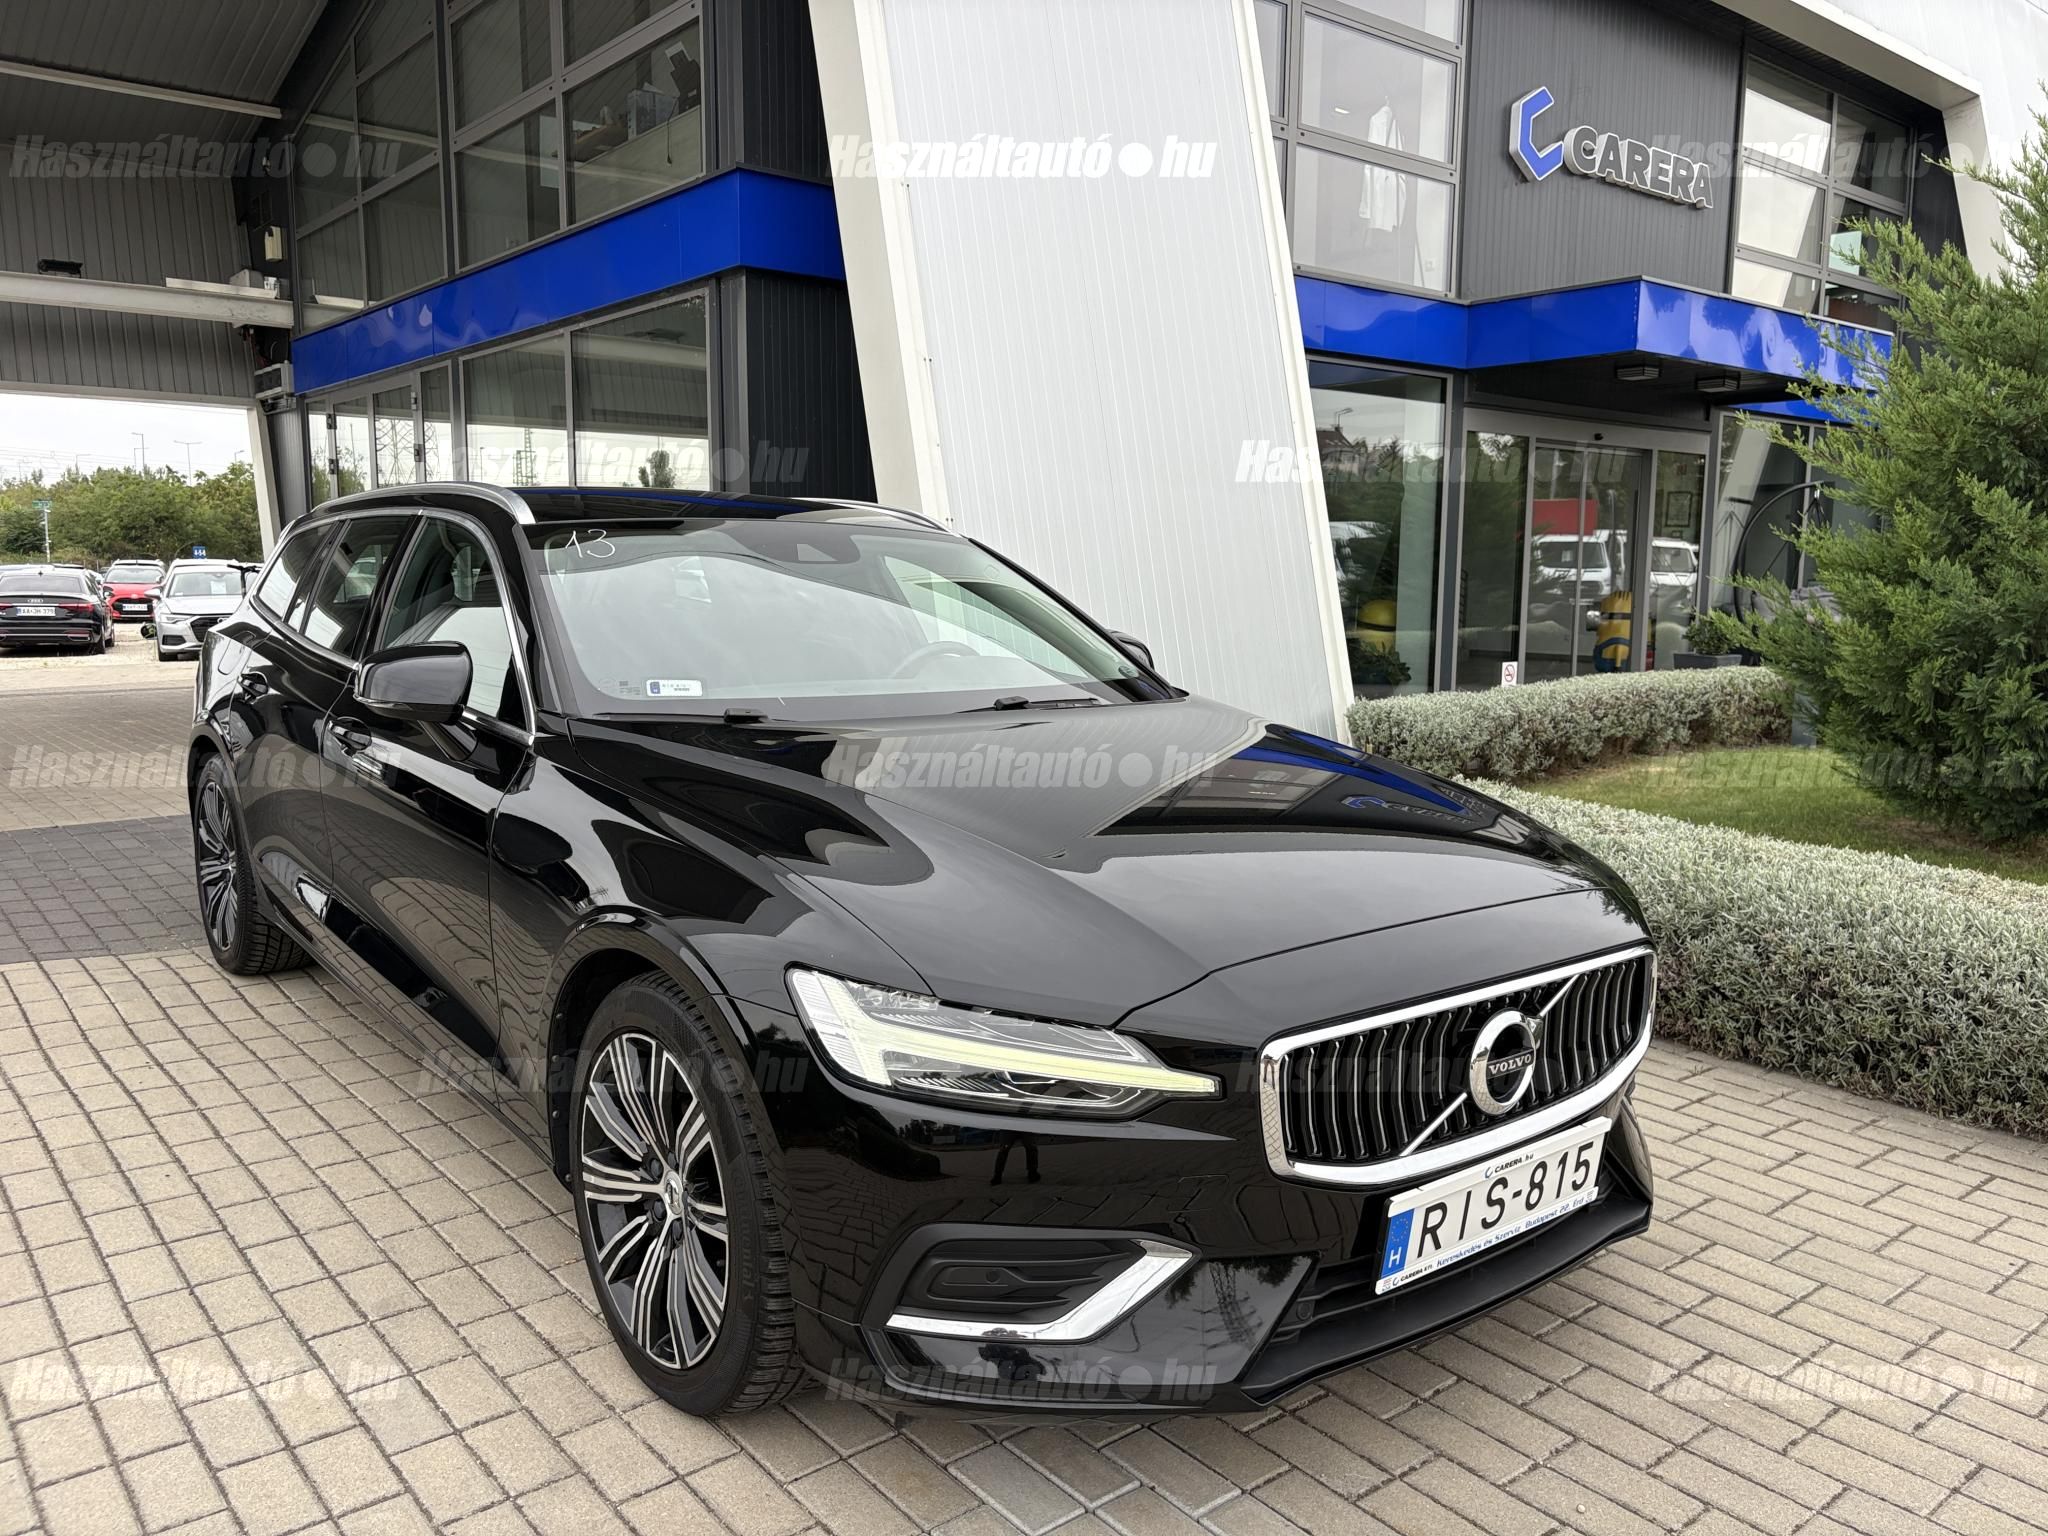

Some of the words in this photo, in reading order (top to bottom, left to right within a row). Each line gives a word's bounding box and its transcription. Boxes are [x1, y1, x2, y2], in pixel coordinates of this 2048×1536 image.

[1565, 125, 1713, 209] CARERA
[564, 528, 616, 559] 13
[1489, 1053, 1532, 1075] VOLVO
[1417, 1141, 1594, 1259] RIS-815
[1525, 1209, 1558, 1229] Budapest
[1388, 1246, 1403, 1269] H
